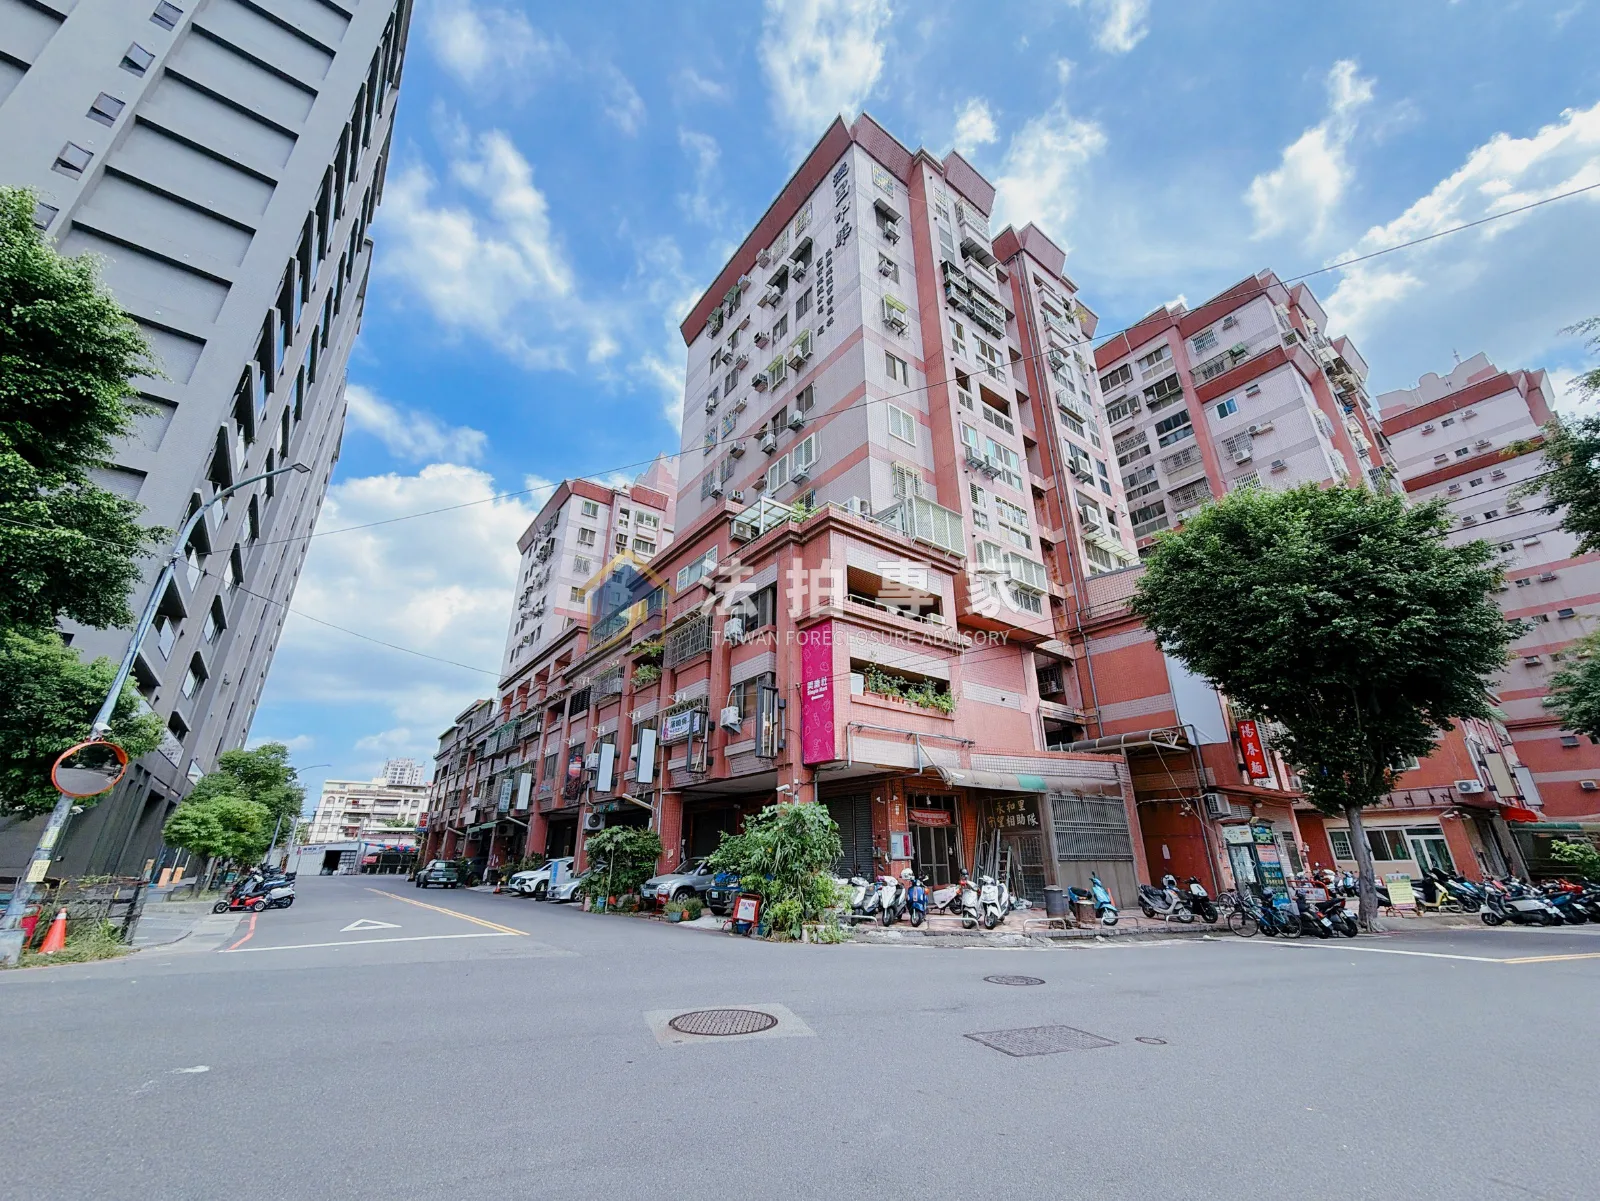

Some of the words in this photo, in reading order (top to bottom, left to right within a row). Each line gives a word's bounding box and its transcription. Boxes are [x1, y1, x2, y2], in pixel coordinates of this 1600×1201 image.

[1240, 723, 1266, 775] 陽春麵
[996, 799, 1026, 815] 永和里
[987, 812, 1039, 828] 守望相助隊
